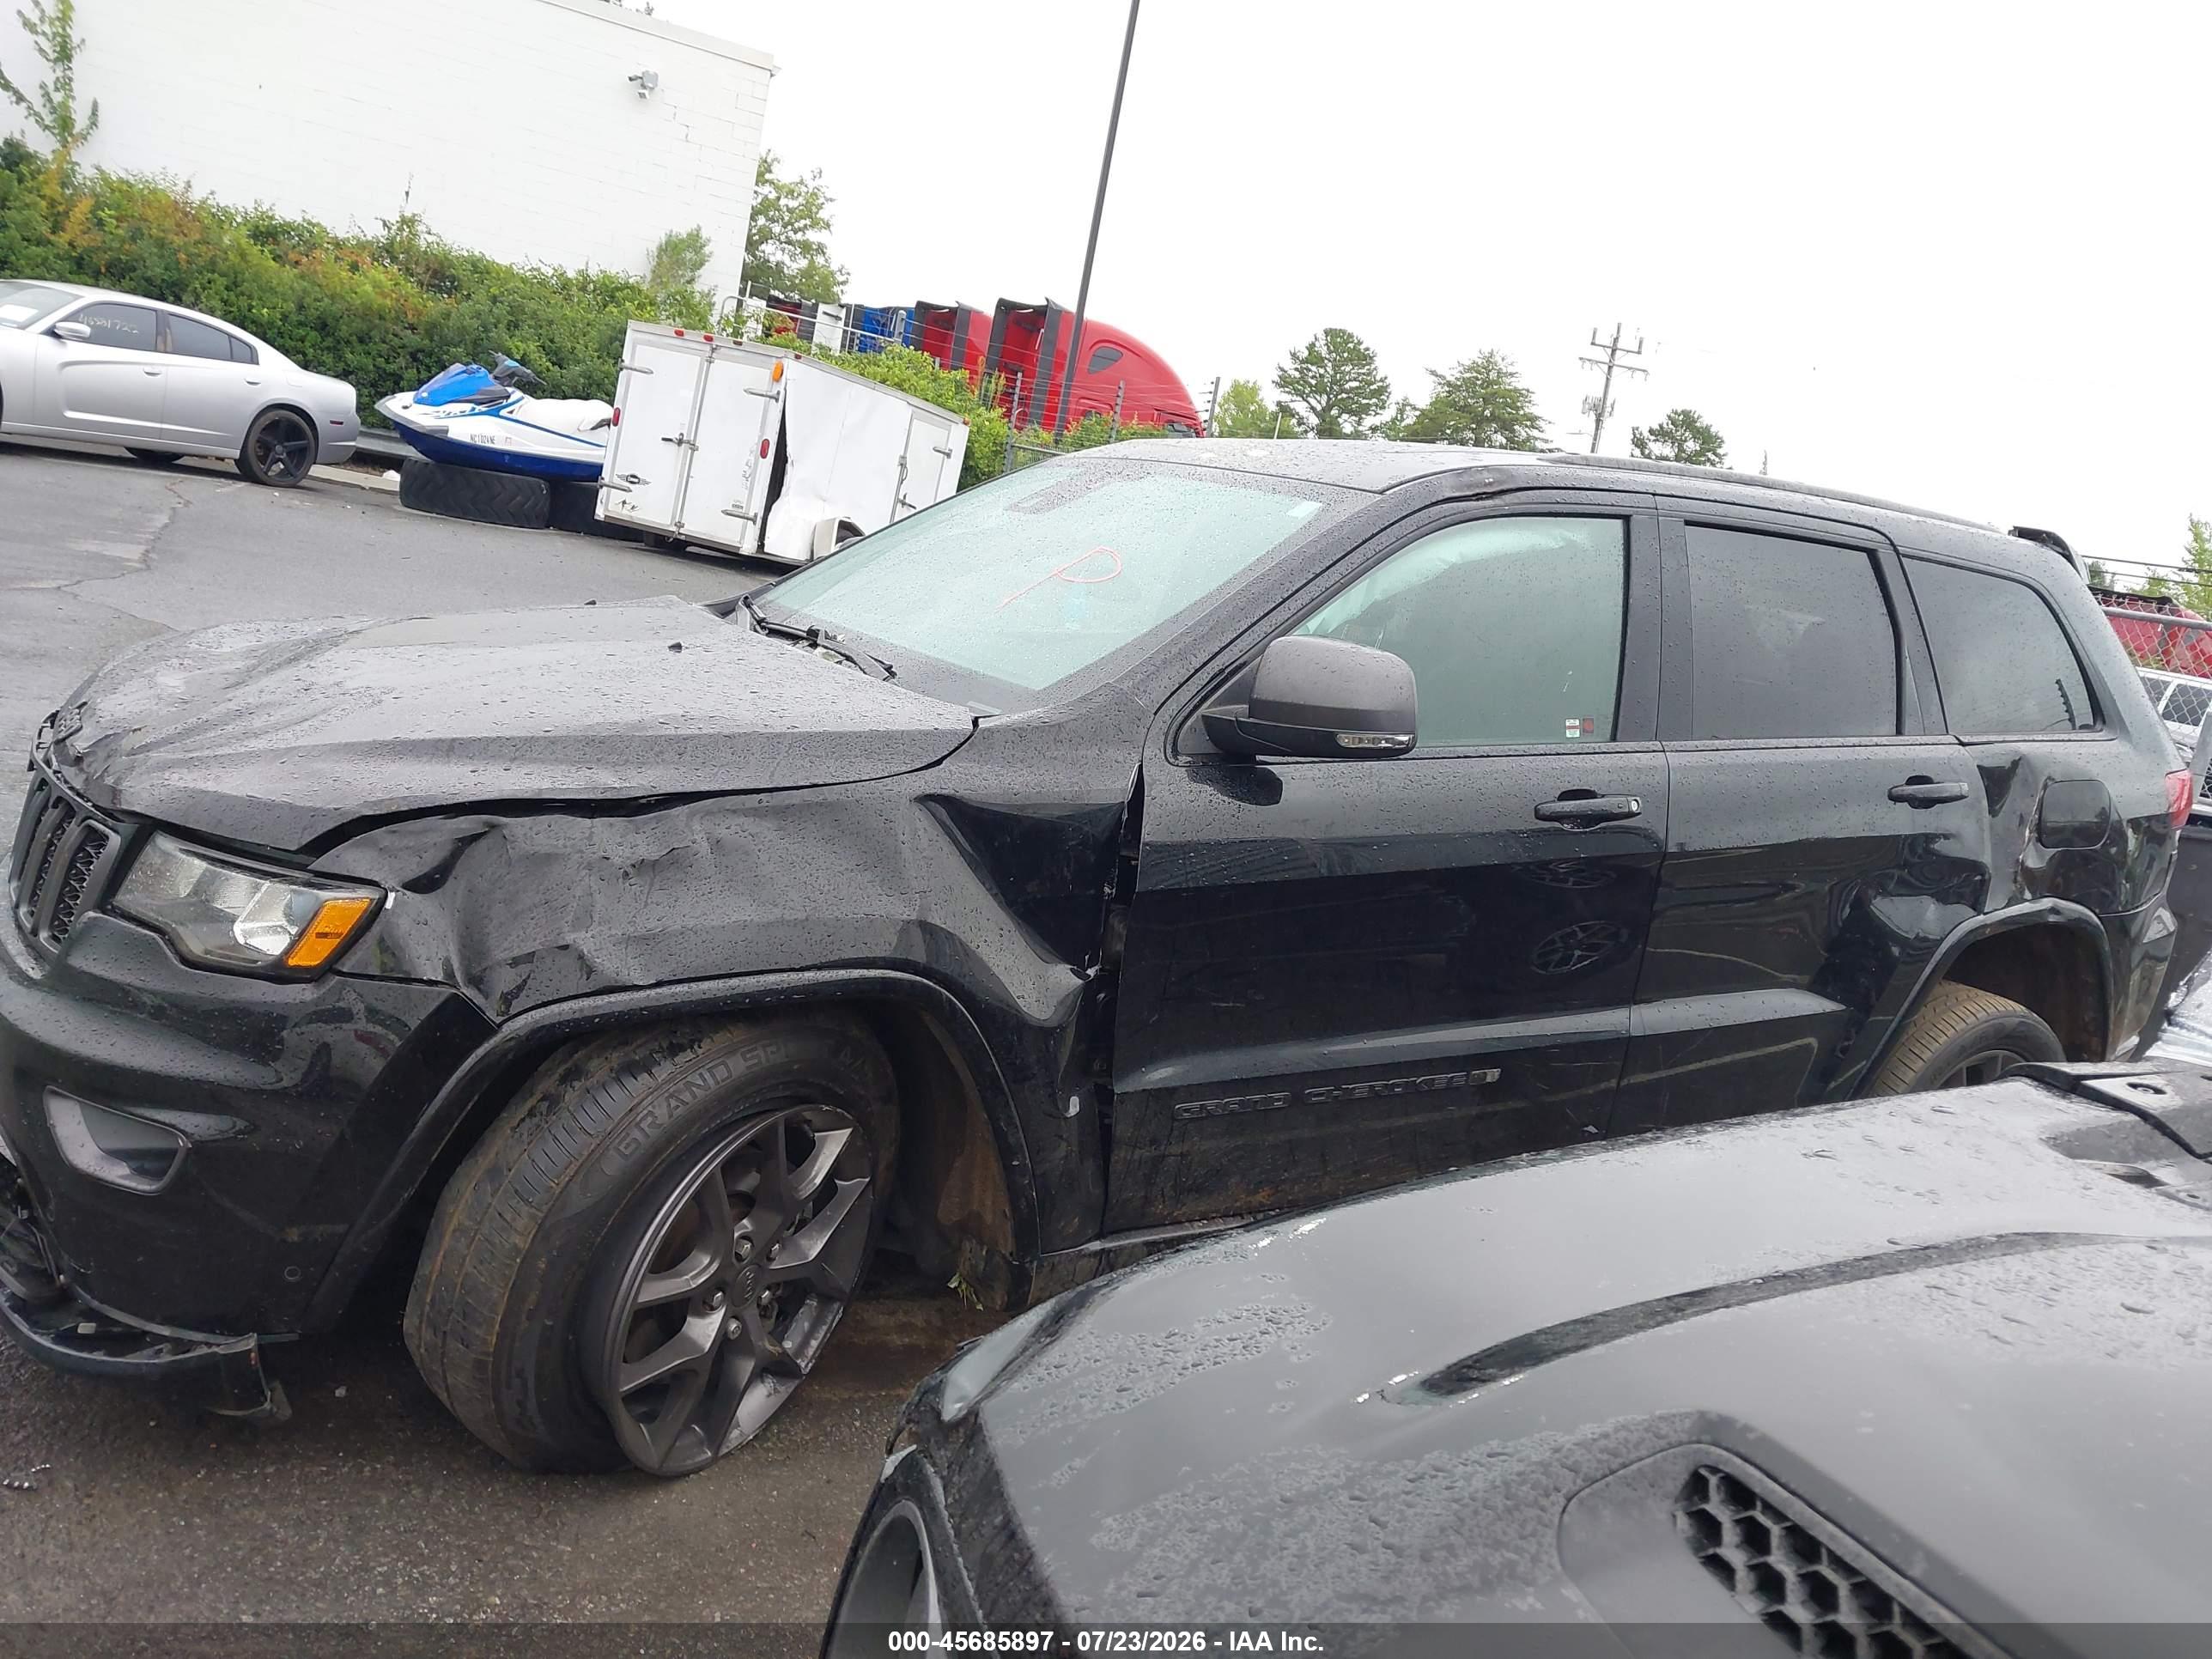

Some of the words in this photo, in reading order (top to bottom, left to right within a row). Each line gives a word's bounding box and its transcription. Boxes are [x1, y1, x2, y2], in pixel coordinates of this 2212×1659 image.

[615, 1060, 733, 1161] GRAND
[1174, 1091, 1291, 1120] GRAND
[1304, 1071, 1468, 1103] CHEROKEE
